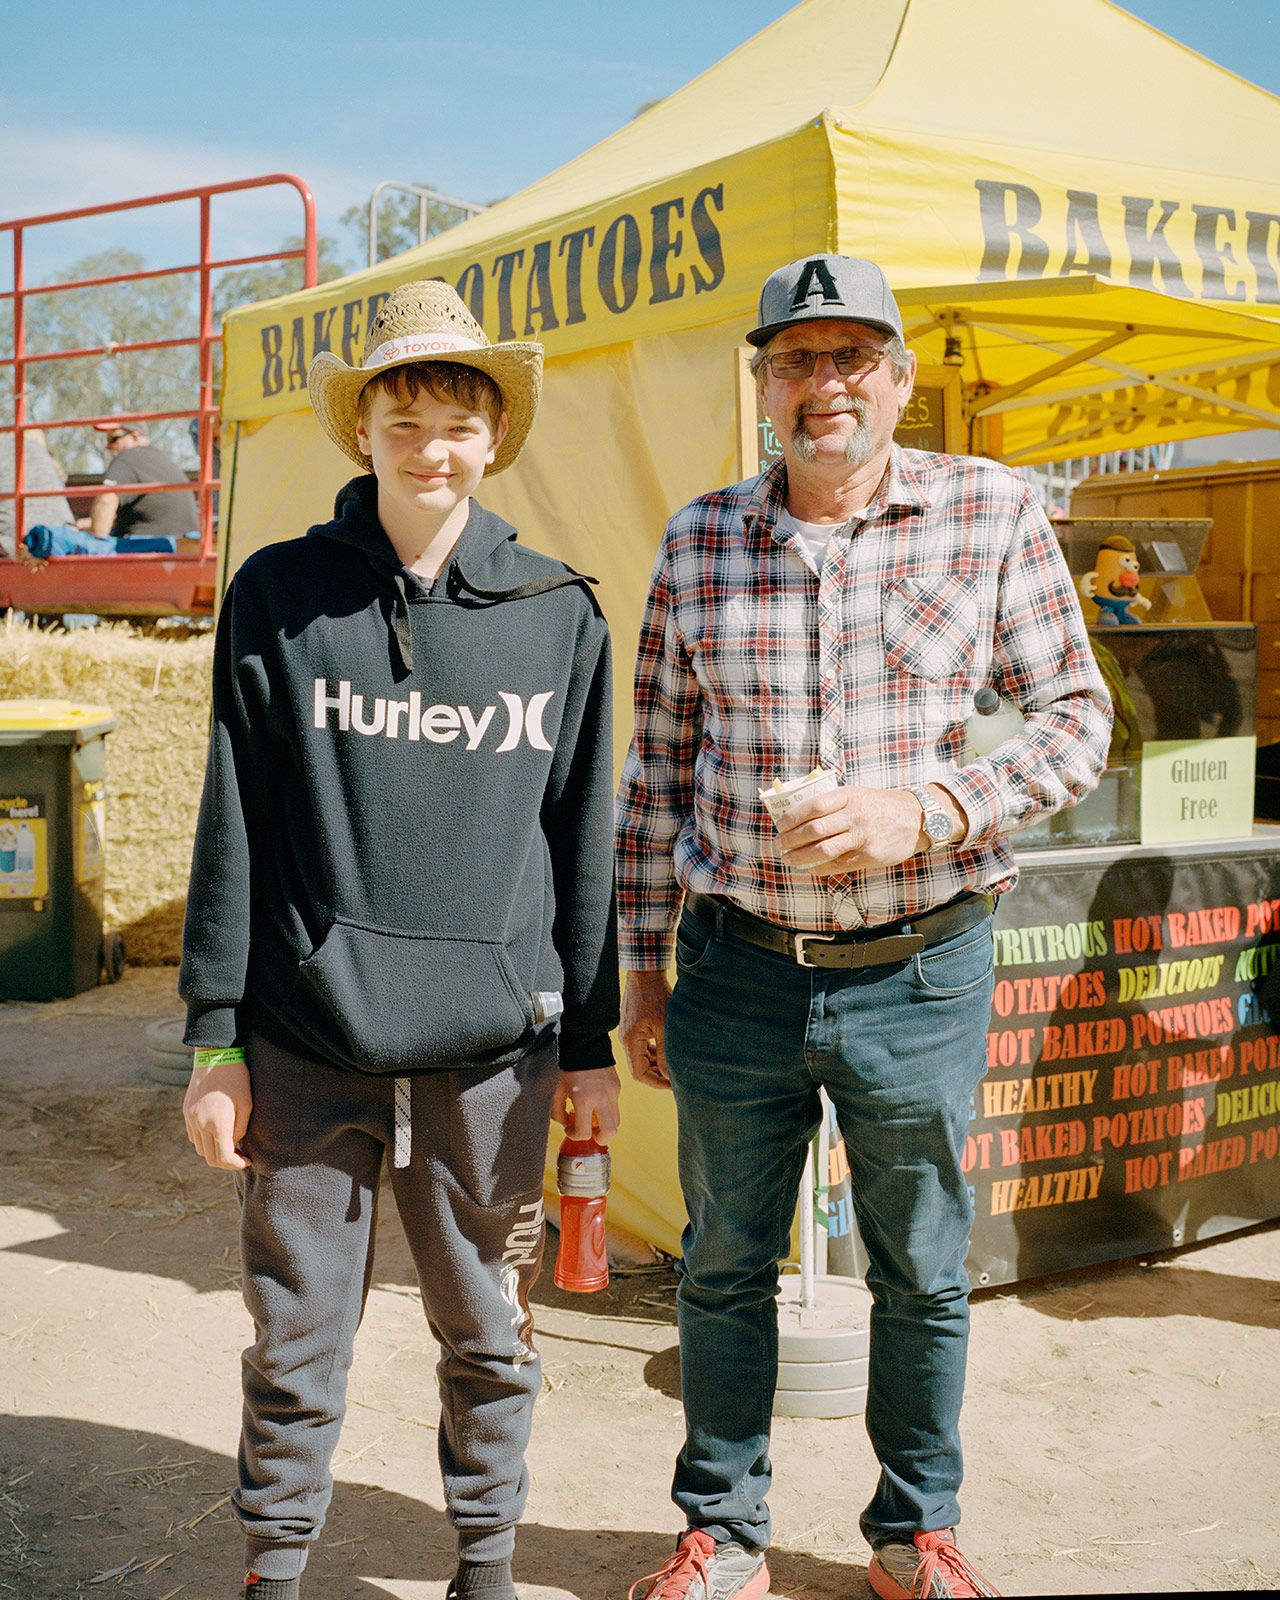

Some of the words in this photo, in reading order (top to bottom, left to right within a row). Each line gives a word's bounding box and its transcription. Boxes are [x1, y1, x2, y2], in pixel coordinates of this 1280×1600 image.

[430, 182, 724, 341] OTATOES
[788, 259, 846, 313] A
[403, 341, 458, 354] TOYOTA
[314, 678, 497, 751] Hurley
[1171, 759, 1227, 784] Gluten
[1180, 796, 1217, 821] Free
[1113, 915, 1163, 955] HOT
[1167, 906, 1241, 949] BAKED
[991, 970, 1106, 1018] OTATOES
[1117, 954, 1225, 1003] DELICIOUS
[1041, 1017, 1127, 1062] BAKED
[1130, 997, 1234, 1050] POTATOES
[982, 1069, 1099, 1119] HEALTHY
[1112, 1059, 1162, 1100] HOT
[1166, 1045, 1234, 1091] BAKED
[960, 1132, 994, 1173] OT
[1000, 1120, 1087, 1167] BAKED
[1092, 1097, 1206, 1152] POTATOES
[990, 1165, 1104, 1216] HEALTHY
[1124, 1151, 1173, 1194] HOT
[1177, 1135, 1246, 1182] BAKED
